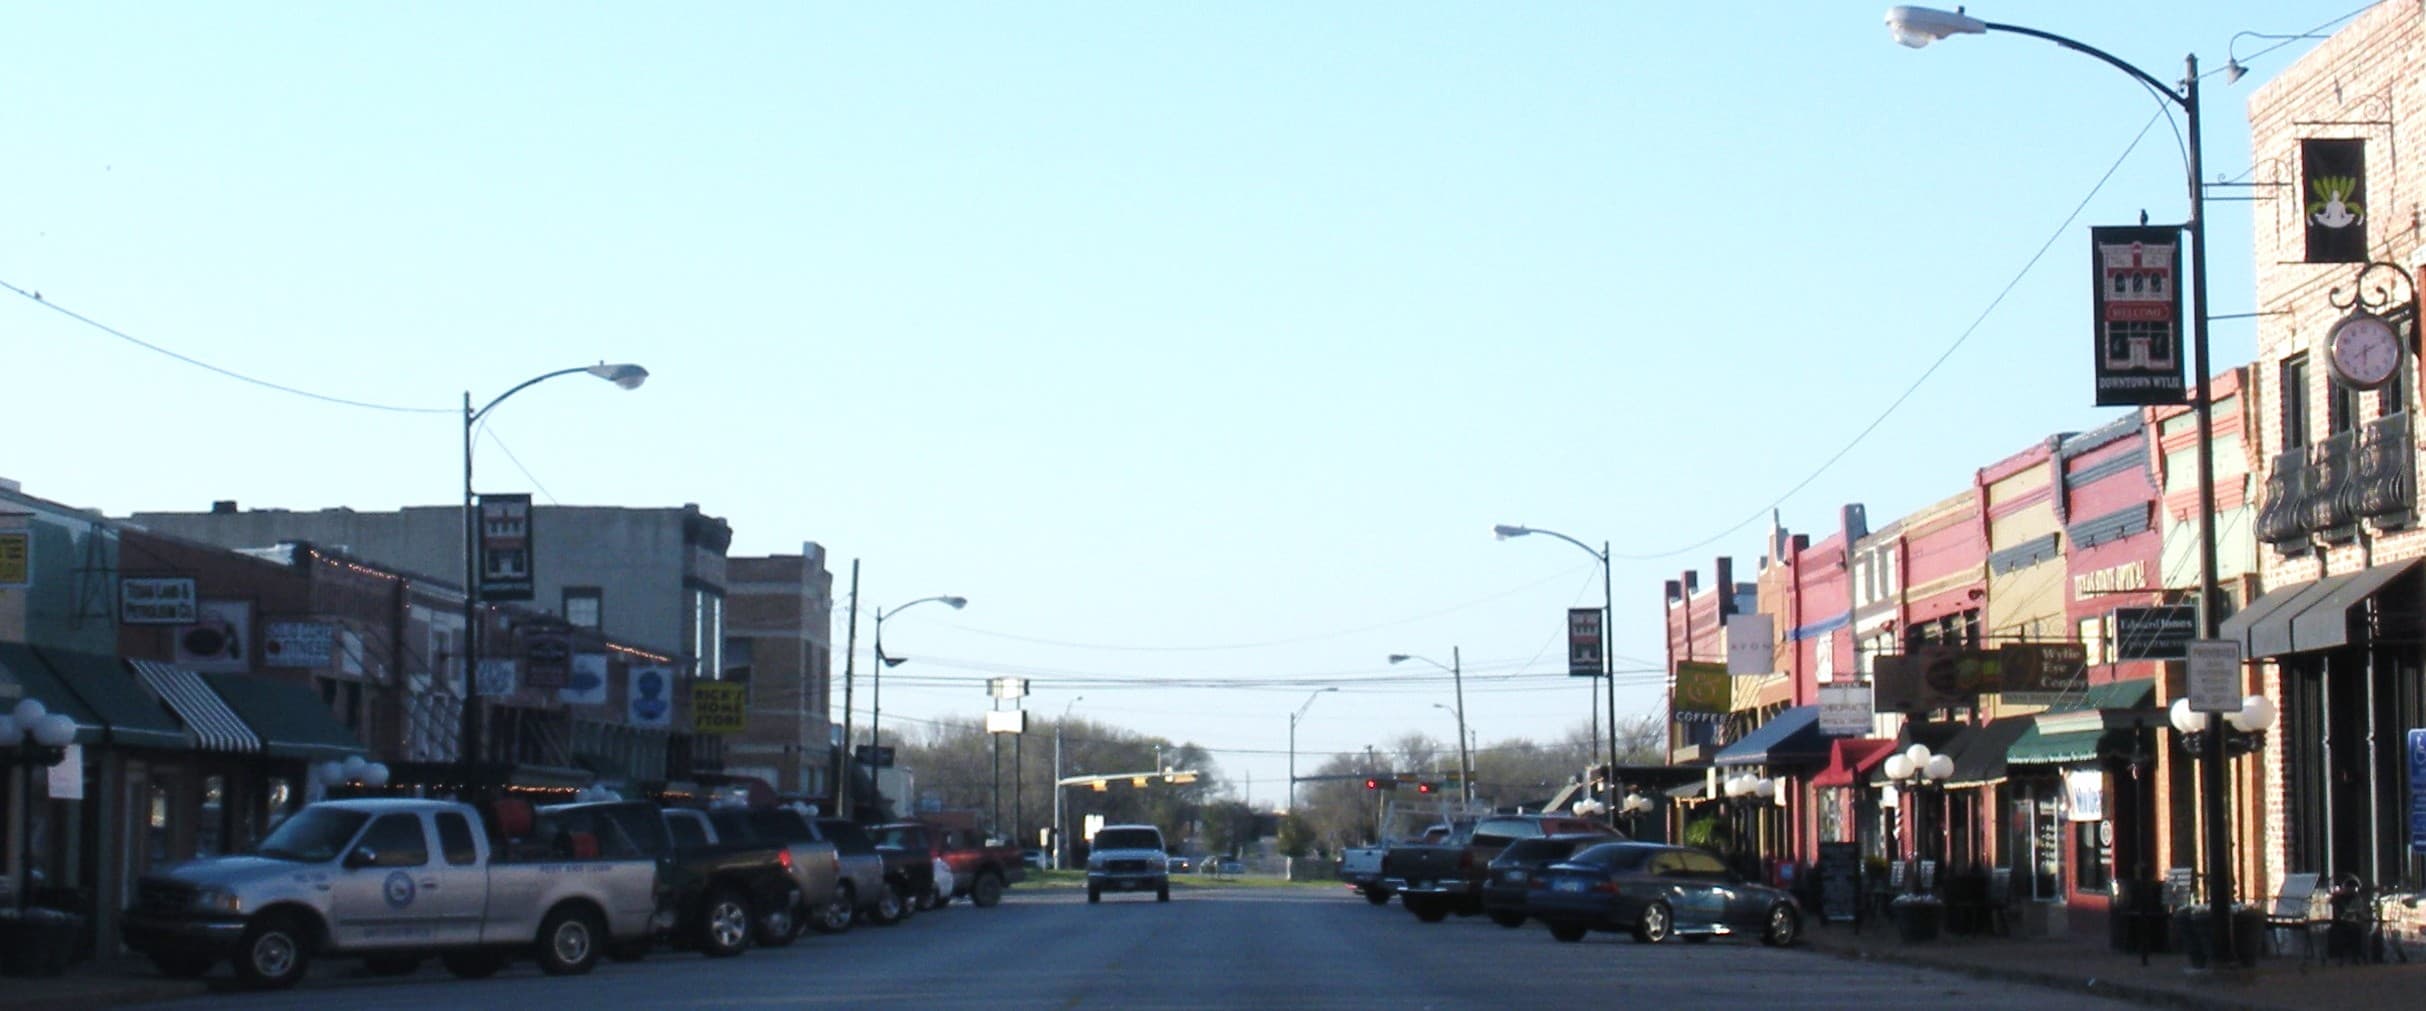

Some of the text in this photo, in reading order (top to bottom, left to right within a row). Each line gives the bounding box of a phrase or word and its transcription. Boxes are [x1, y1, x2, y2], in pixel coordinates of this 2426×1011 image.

[2111, 305, 2162, 317] WELCOME
[2099, 375, 2180, 389] DOWNTOWN WYLIE
[1730, 642, 1771, 651] AVON
[2041, 647, 2081, 661] Wylie
[2041, 661, 2067, 674] Eye
[2040, 676, 2086, 688] Center
[696, 702, 741, 713] HOME
[1675, 711, 1728, 723] COFFEE
